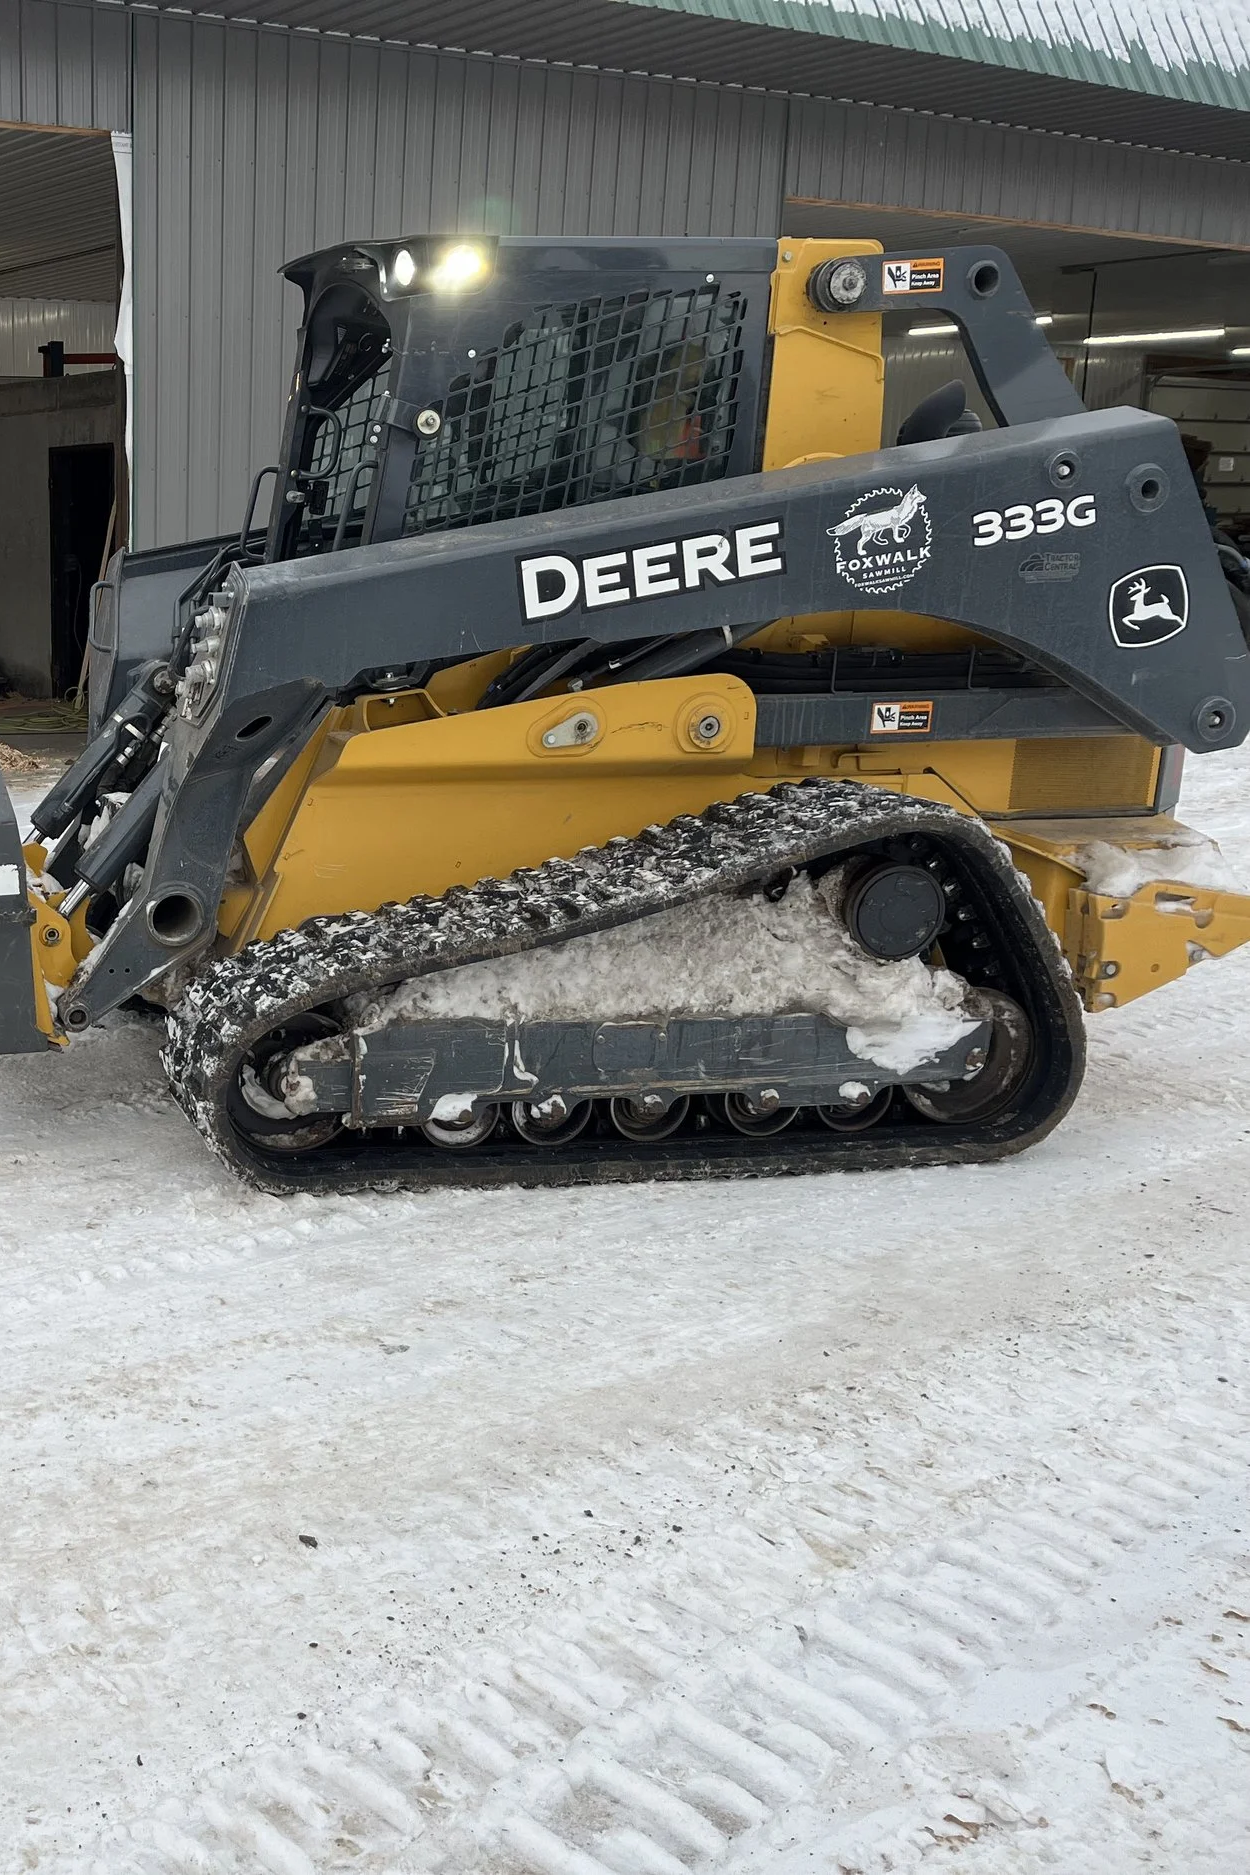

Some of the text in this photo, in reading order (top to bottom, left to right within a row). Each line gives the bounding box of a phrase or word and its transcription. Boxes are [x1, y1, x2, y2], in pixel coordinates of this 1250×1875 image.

[972, 495, 1096, 547] 333G
[520, 521, 782, 620] DEERE
[836, 546, 932, 574] FOXWALK
[862, 566, 906, 579] SAWMILL
